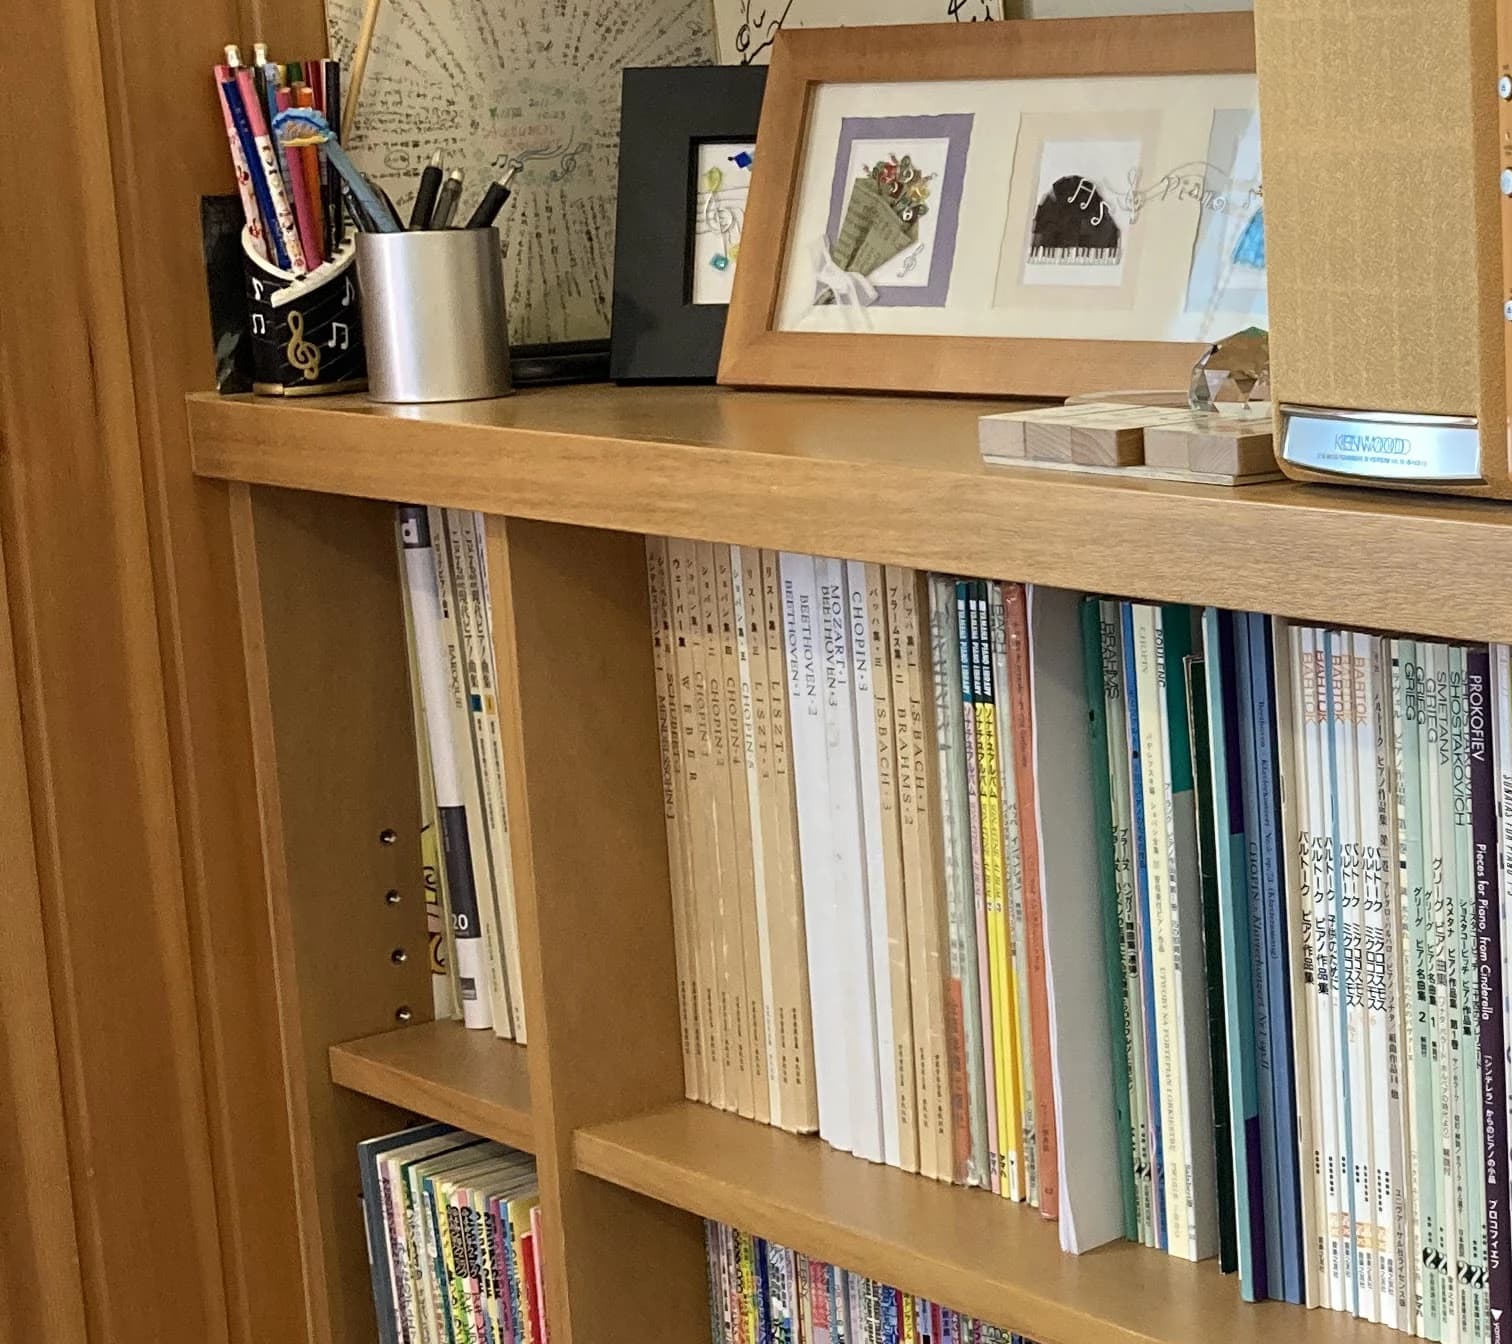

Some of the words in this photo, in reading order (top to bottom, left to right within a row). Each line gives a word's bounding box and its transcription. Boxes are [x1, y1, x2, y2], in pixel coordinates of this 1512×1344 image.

[1334, 433, 1412, 455] KENWOOD
[960, 641, 969, 663] PIANO
[962, 664, 971, 695] LIBRARY
[971, 641, 980, 664] PIANO
[972, 665, 982, 696] LIBRARY
[981, 642, 990, 664] PIANO
[982, 665, 992, 696] LIBRARY
[1104, 622, 1120, 700] BRAHMS
[1154, 628, 1166, 689] POULENC
[1331, 655, 1344, 726] BARTOK
[1354, 657, 1367, 728] BARTOK
[1404, 662, 1416, 721] GRIEG
[1415, 666, 1426, 725] GRIEG
[1425, 678, 1438, 744] GRIEG
[1437, 670, 1450, 766] SMETANA
[1468, 675, 1485, 762] PROKOFIEV
[1450, 670, 1466, 827] SHOSTAKOVICH
[1475, 844, 1488, 878] Pieces
[1477, 879, 1488, 896] for
[1479, 936, 1491, 962] from
[1480, 964, 1493, 1021] Cinderella
